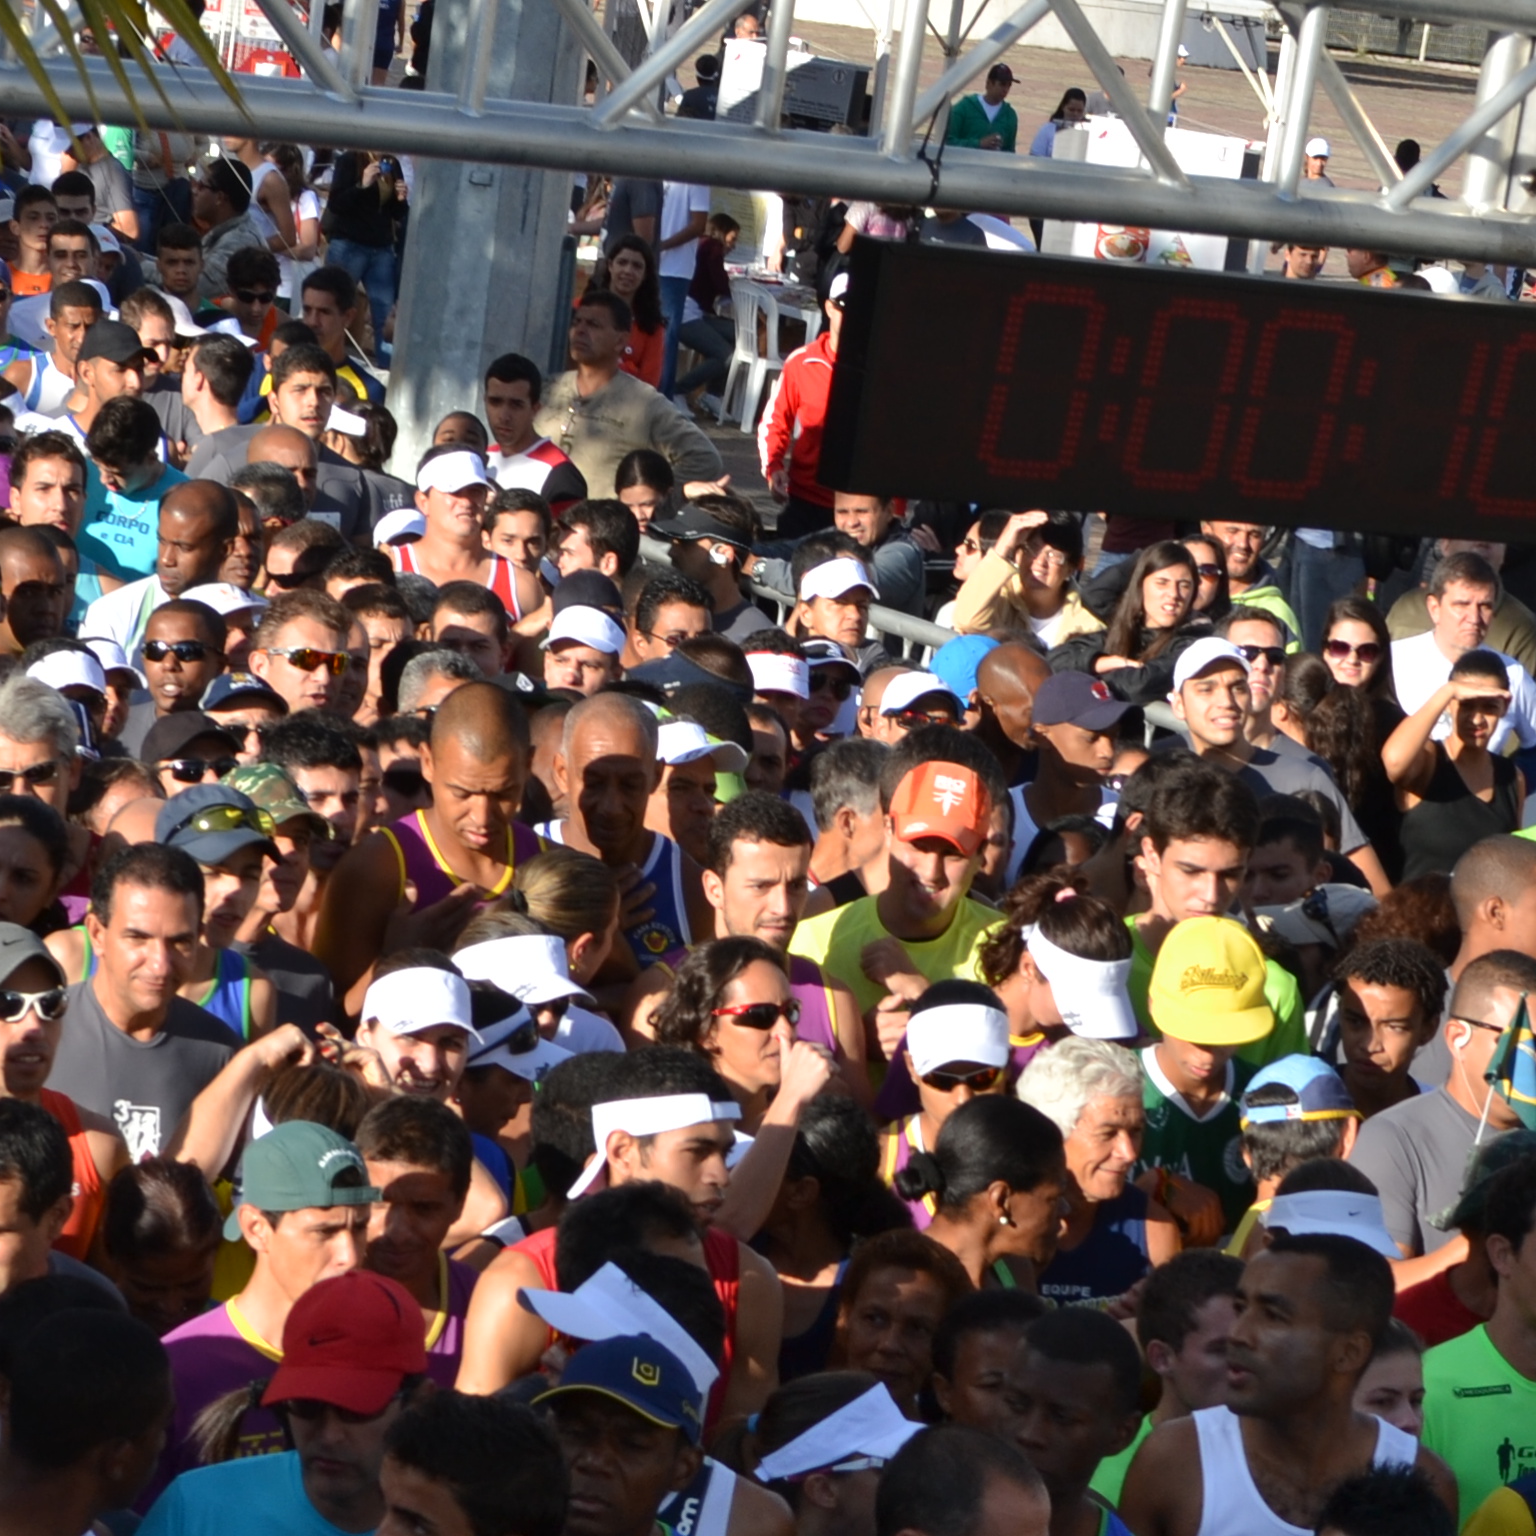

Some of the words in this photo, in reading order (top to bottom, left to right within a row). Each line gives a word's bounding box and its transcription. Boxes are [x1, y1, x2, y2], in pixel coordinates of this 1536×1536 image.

[95, 512, 150, 535] CORPO
[113, 532, 135, 547] CIA
[1041, 1283, 1092, 1298] EQUIPE
